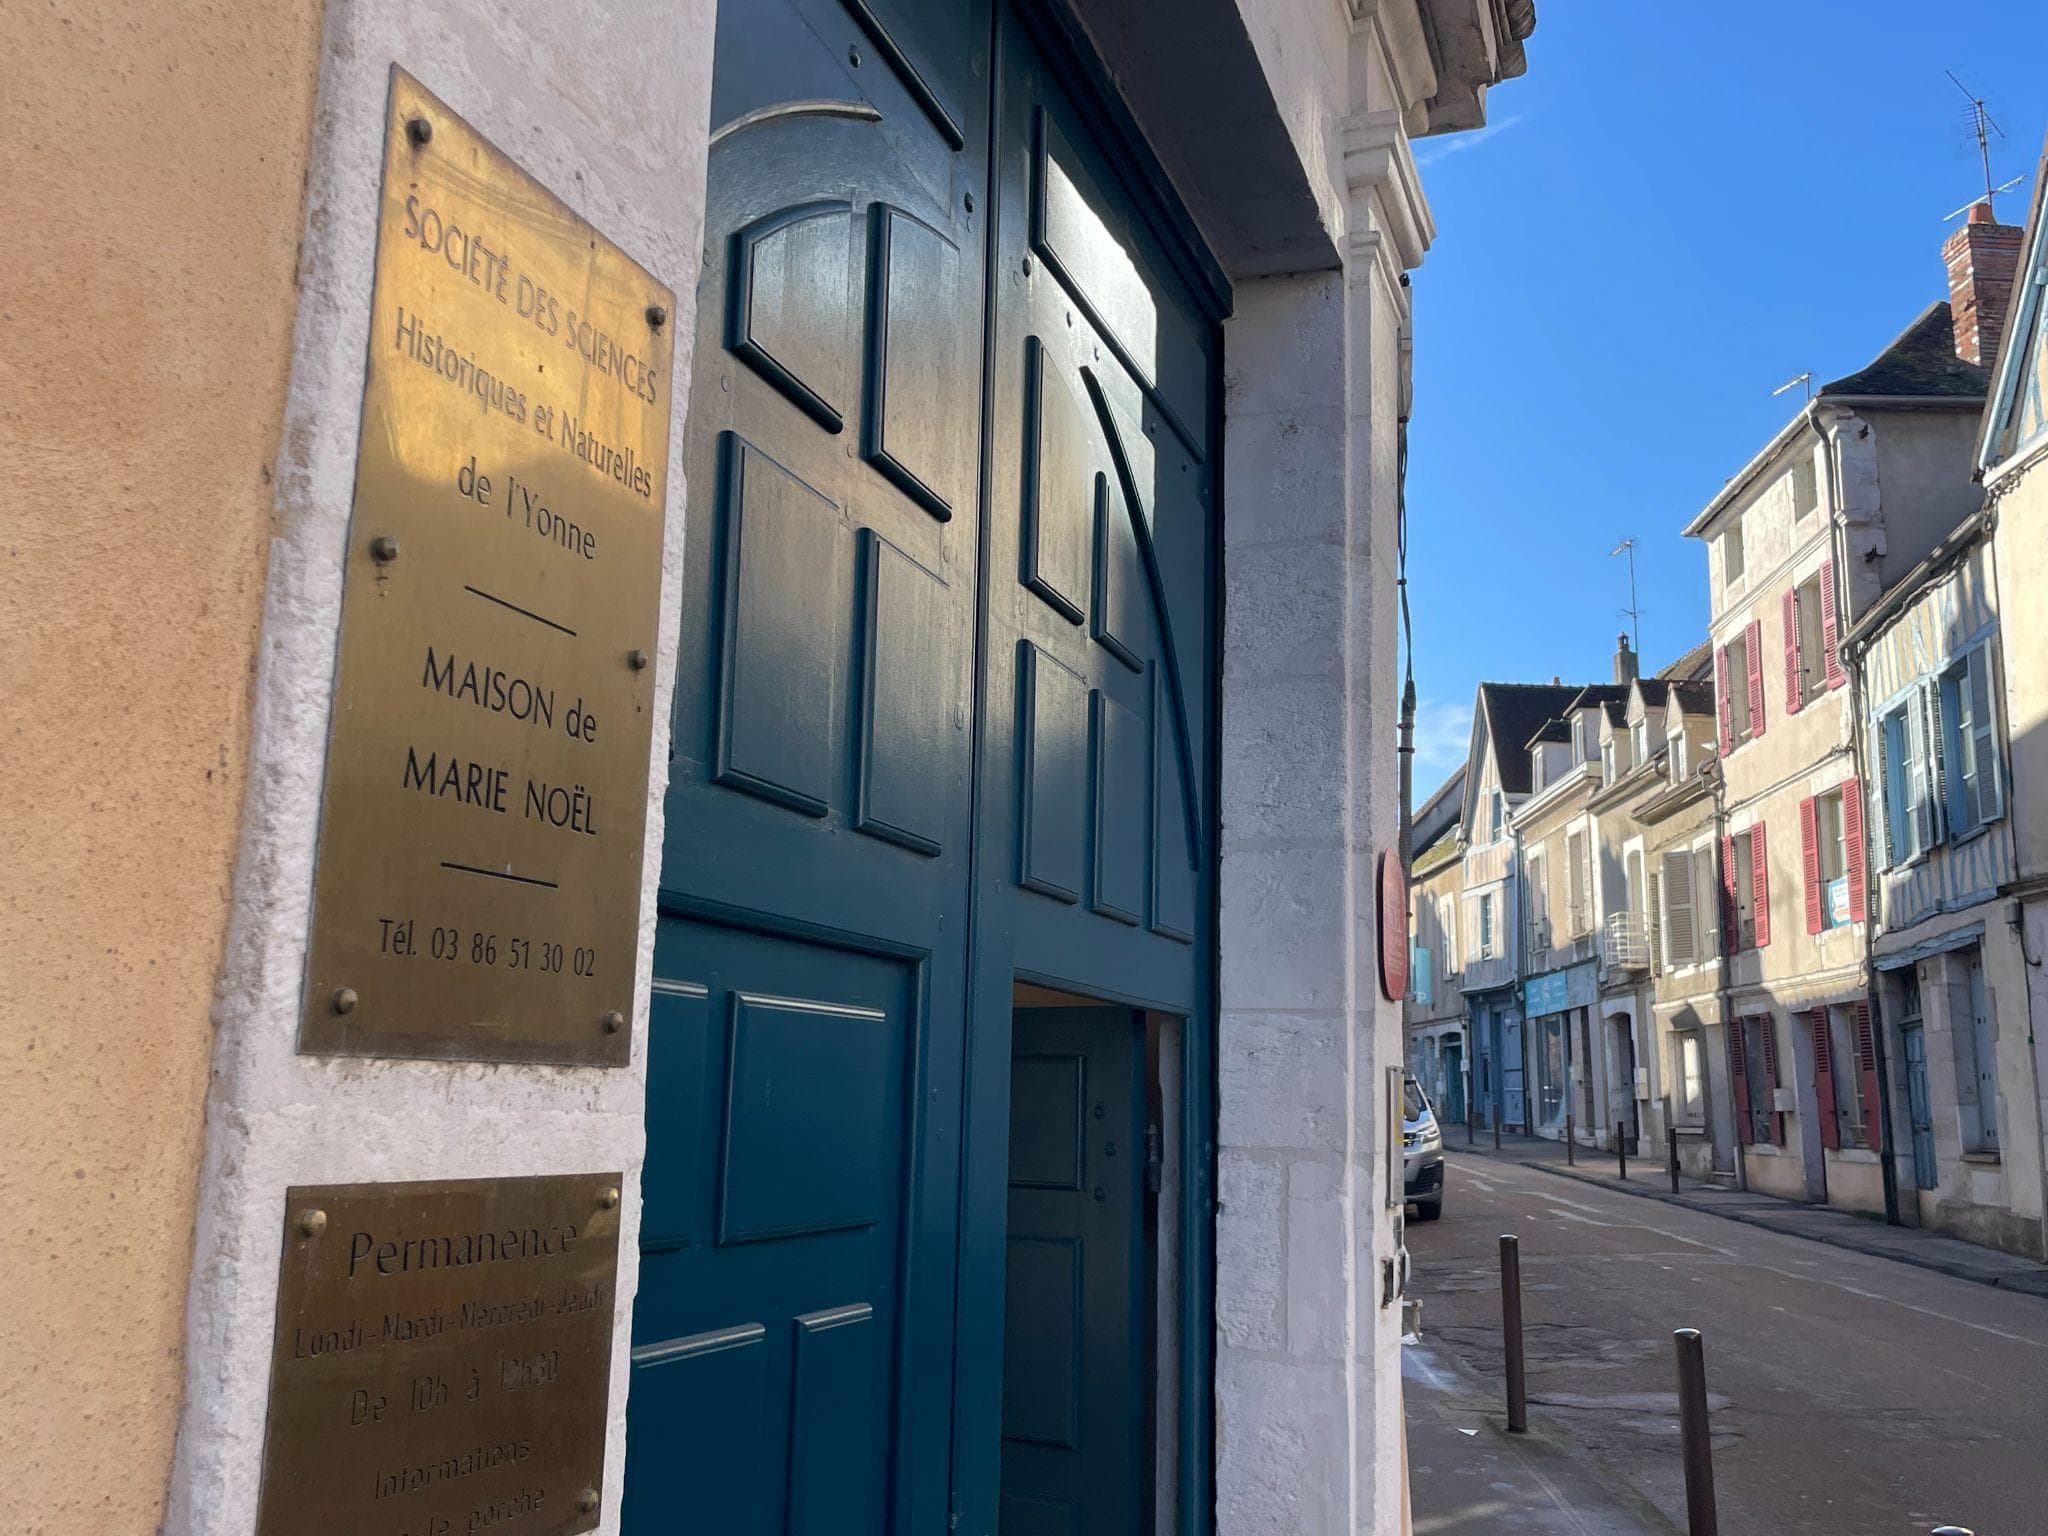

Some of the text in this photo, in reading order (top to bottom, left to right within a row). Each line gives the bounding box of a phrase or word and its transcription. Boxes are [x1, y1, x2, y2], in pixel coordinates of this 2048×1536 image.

[404, 194, 657, 406] SOCIÉTÉ DES SCIENCES
[396, 307, 652, 499] Historiques et Naturelles
[458, 456, 596, 561] de l'Yonne
[423, 646, 597, 743] MAISON de
[403, 745, 596, 835] MARIE NOËL
[379, 918, 595, 977] Tél. 03 86 51 30 02
[350, 1224, 577, 1279] Permanence
[351, 1389, 387, 1426] De
[410, 1375, 448, 1412] 10h
[467, 1368, 481, 1401] à
[375, 1438, 530, 1500] Informations
[469, 1487, 545, 1536] porche
